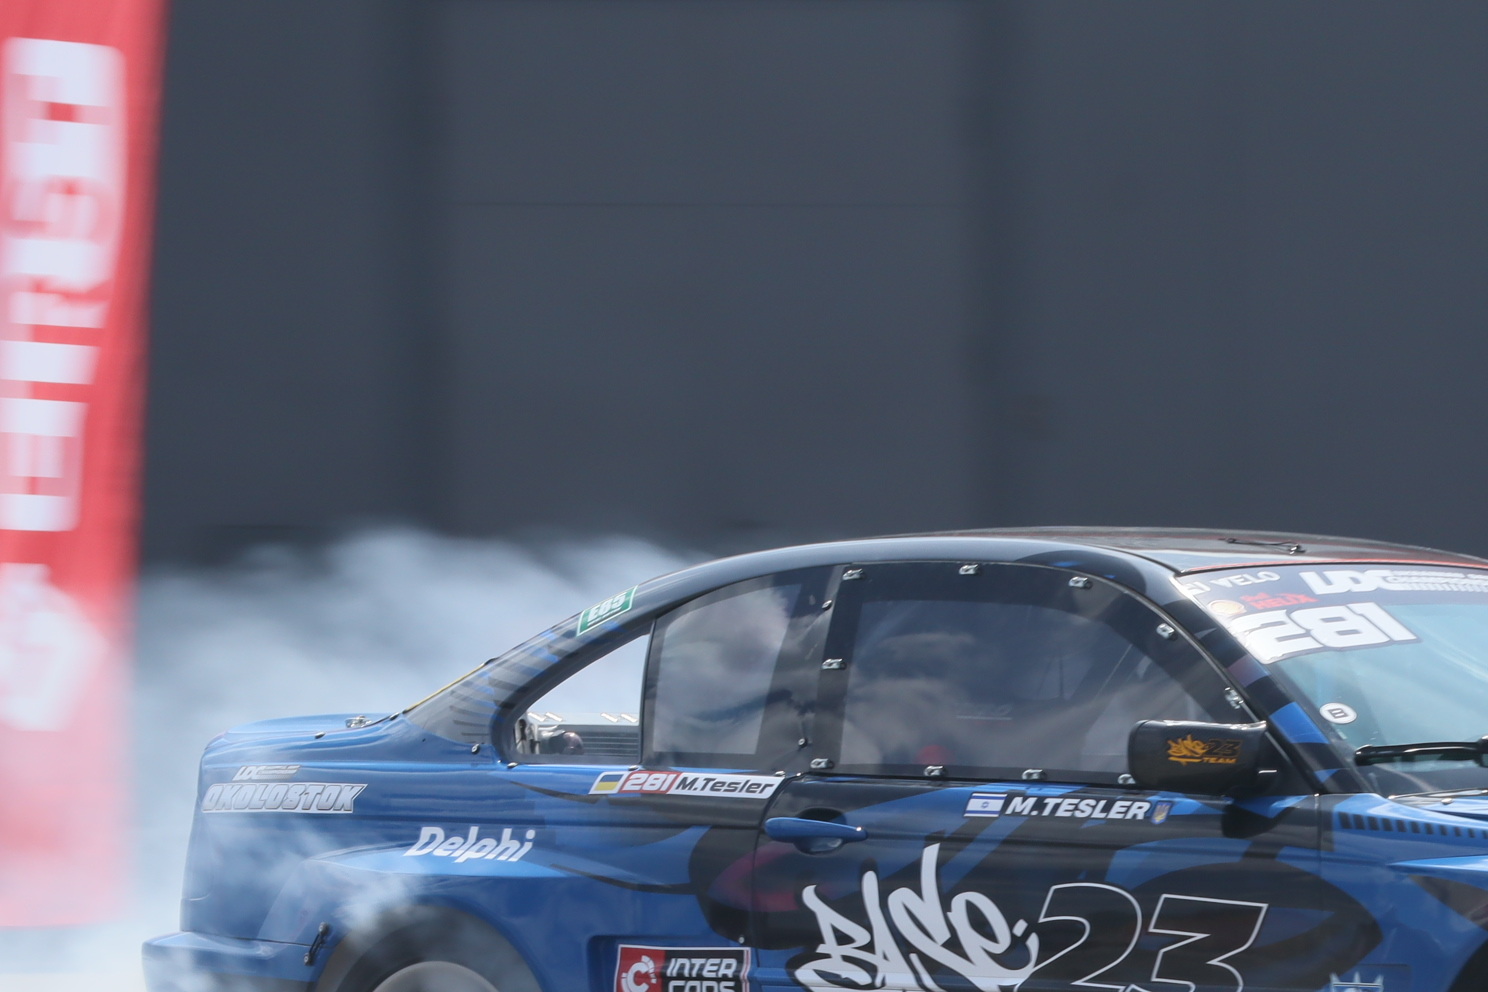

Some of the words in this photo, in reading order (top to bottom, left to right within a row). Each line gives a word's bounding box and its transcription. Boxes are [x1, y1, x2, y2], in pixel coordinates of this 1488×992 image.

[1229, 601, 1418, 664] 281
[622, 773, 677, 792] 281
[675, 775, 777, 795] M.Tesler
[1005, 796, 1151, 820] M.TESLER
[402, 825, 537, 863] Delphi
[666, 958, 737, 978] INTER
